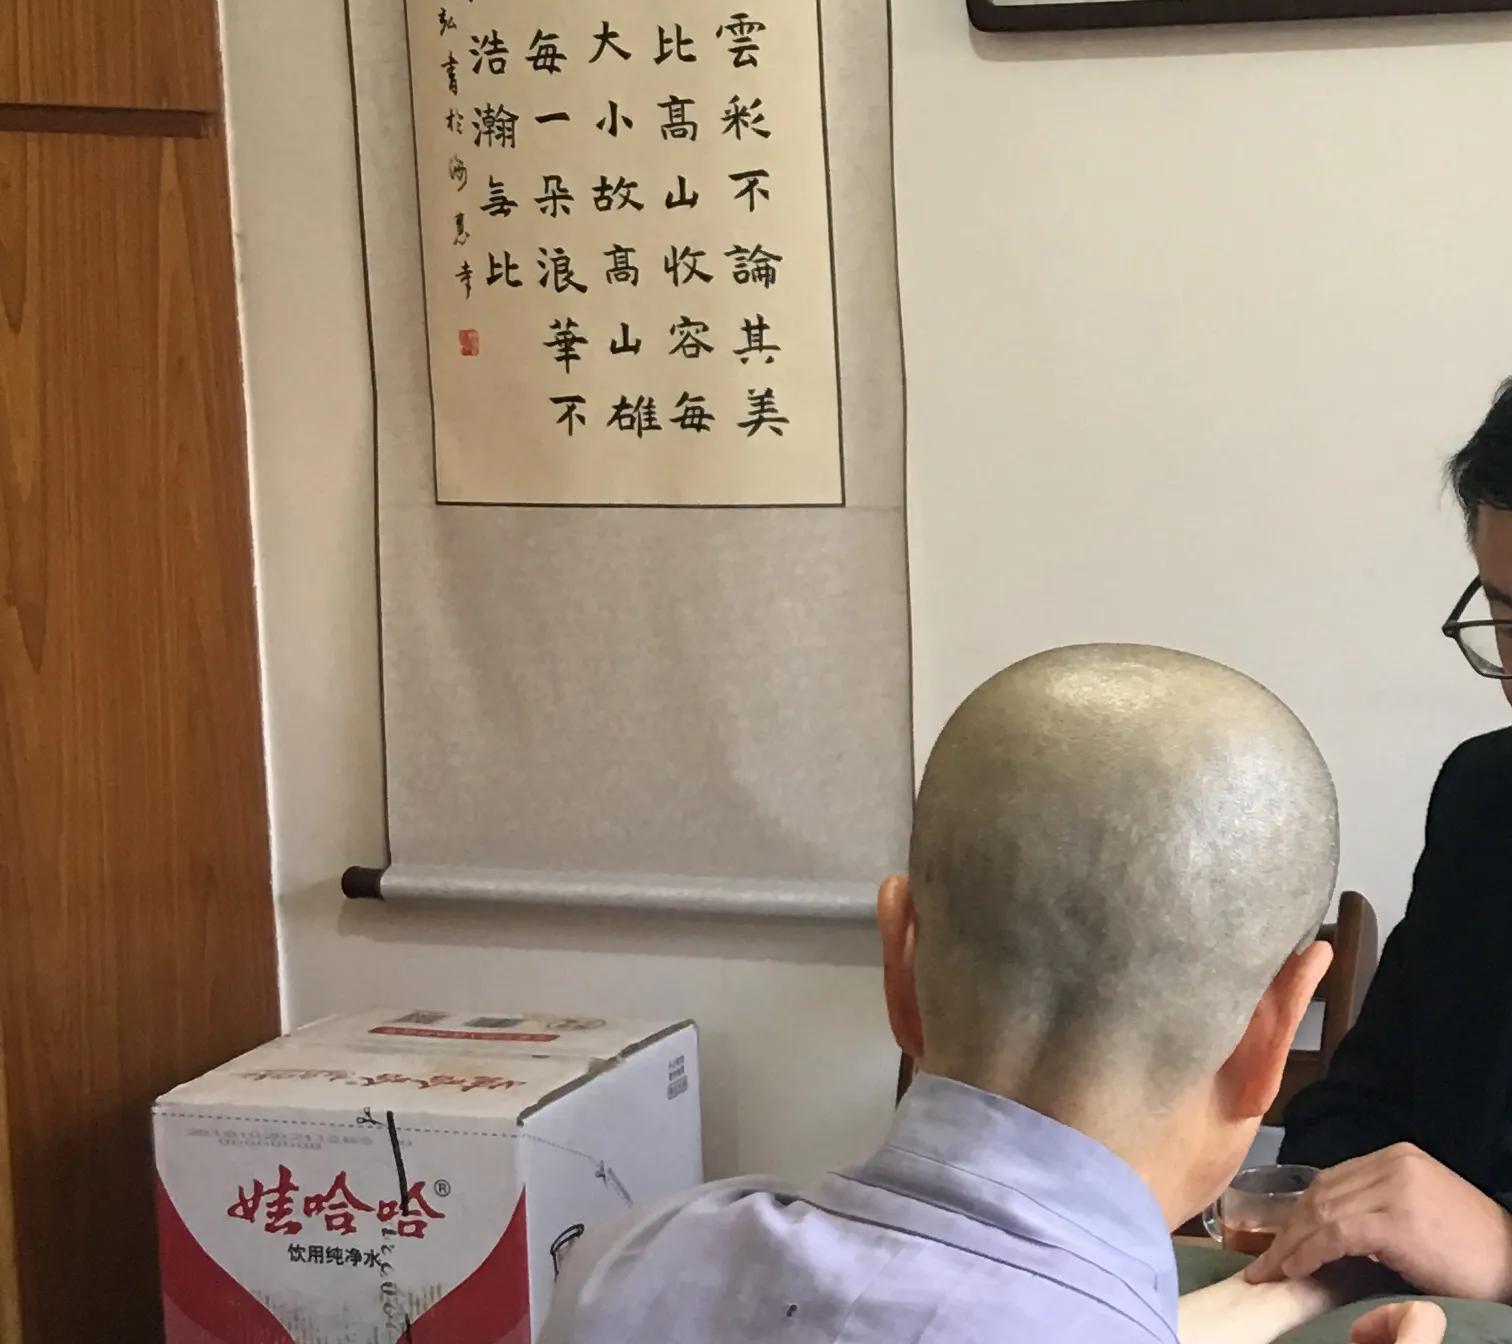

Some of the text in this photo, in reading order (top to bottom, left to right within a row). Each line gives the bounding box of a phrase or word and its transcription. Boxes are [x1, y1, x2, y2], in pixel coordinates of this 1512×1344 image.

[227, 1164, 446, 1239] 娃哈哈
[287, 1242, 384, 1269] 饮用纯净水
